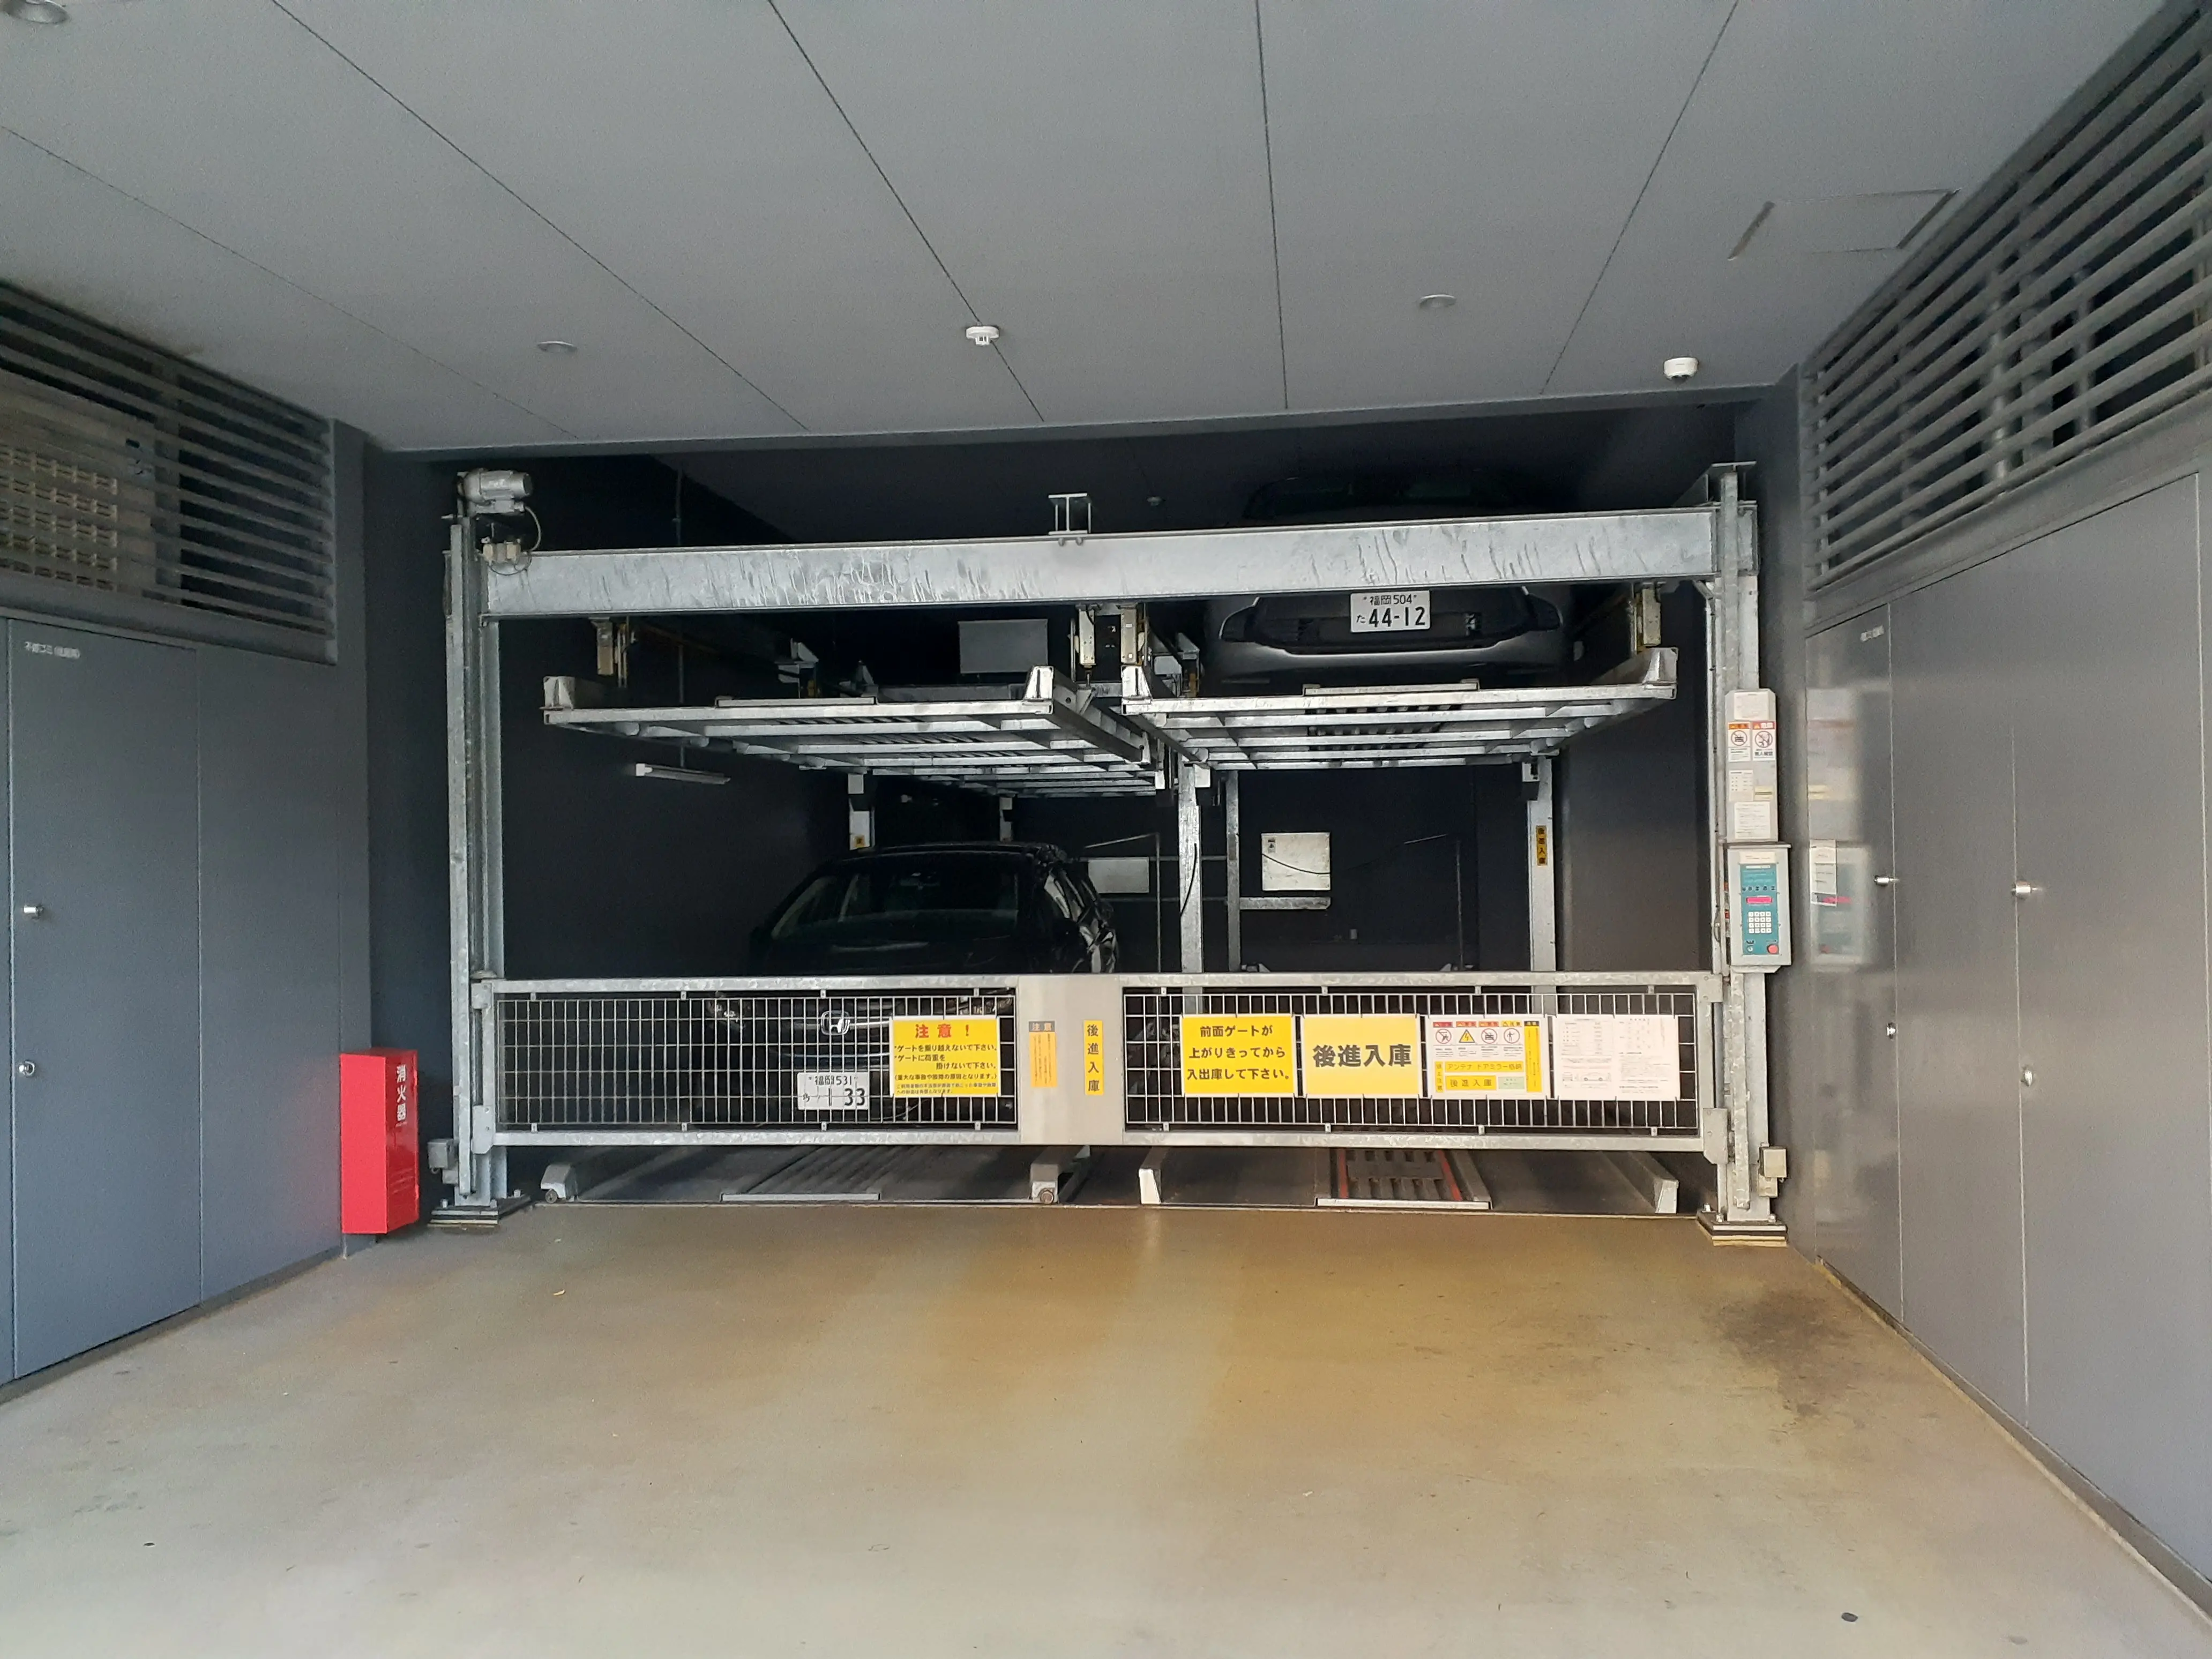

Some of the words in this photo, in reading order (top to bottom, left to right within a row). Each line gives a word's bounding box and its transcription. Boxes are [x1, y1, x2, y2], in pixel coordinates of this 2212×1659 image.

[1369, 595, 1392, 606] 福岡
[1393, 594, 1412, 605] 504
[1356, 614, 1366, 623] た
[1369, 607, 1425, 627] 44-12
[1200, 1025, 1273, 1038] 前面ゲートが
[1087, 1024, 1100, 1092] 後進入庫
[1189, 1047, 1286, 1059] 上がりきってから
[1312, 1044, 1412, 1068] 後進入庫
[835, 1075, 852, 1086] 531
[1187, 1068, 1290, 1081] 入出庫して下さい。
[397, 1064, 406, 1121] 消火器
